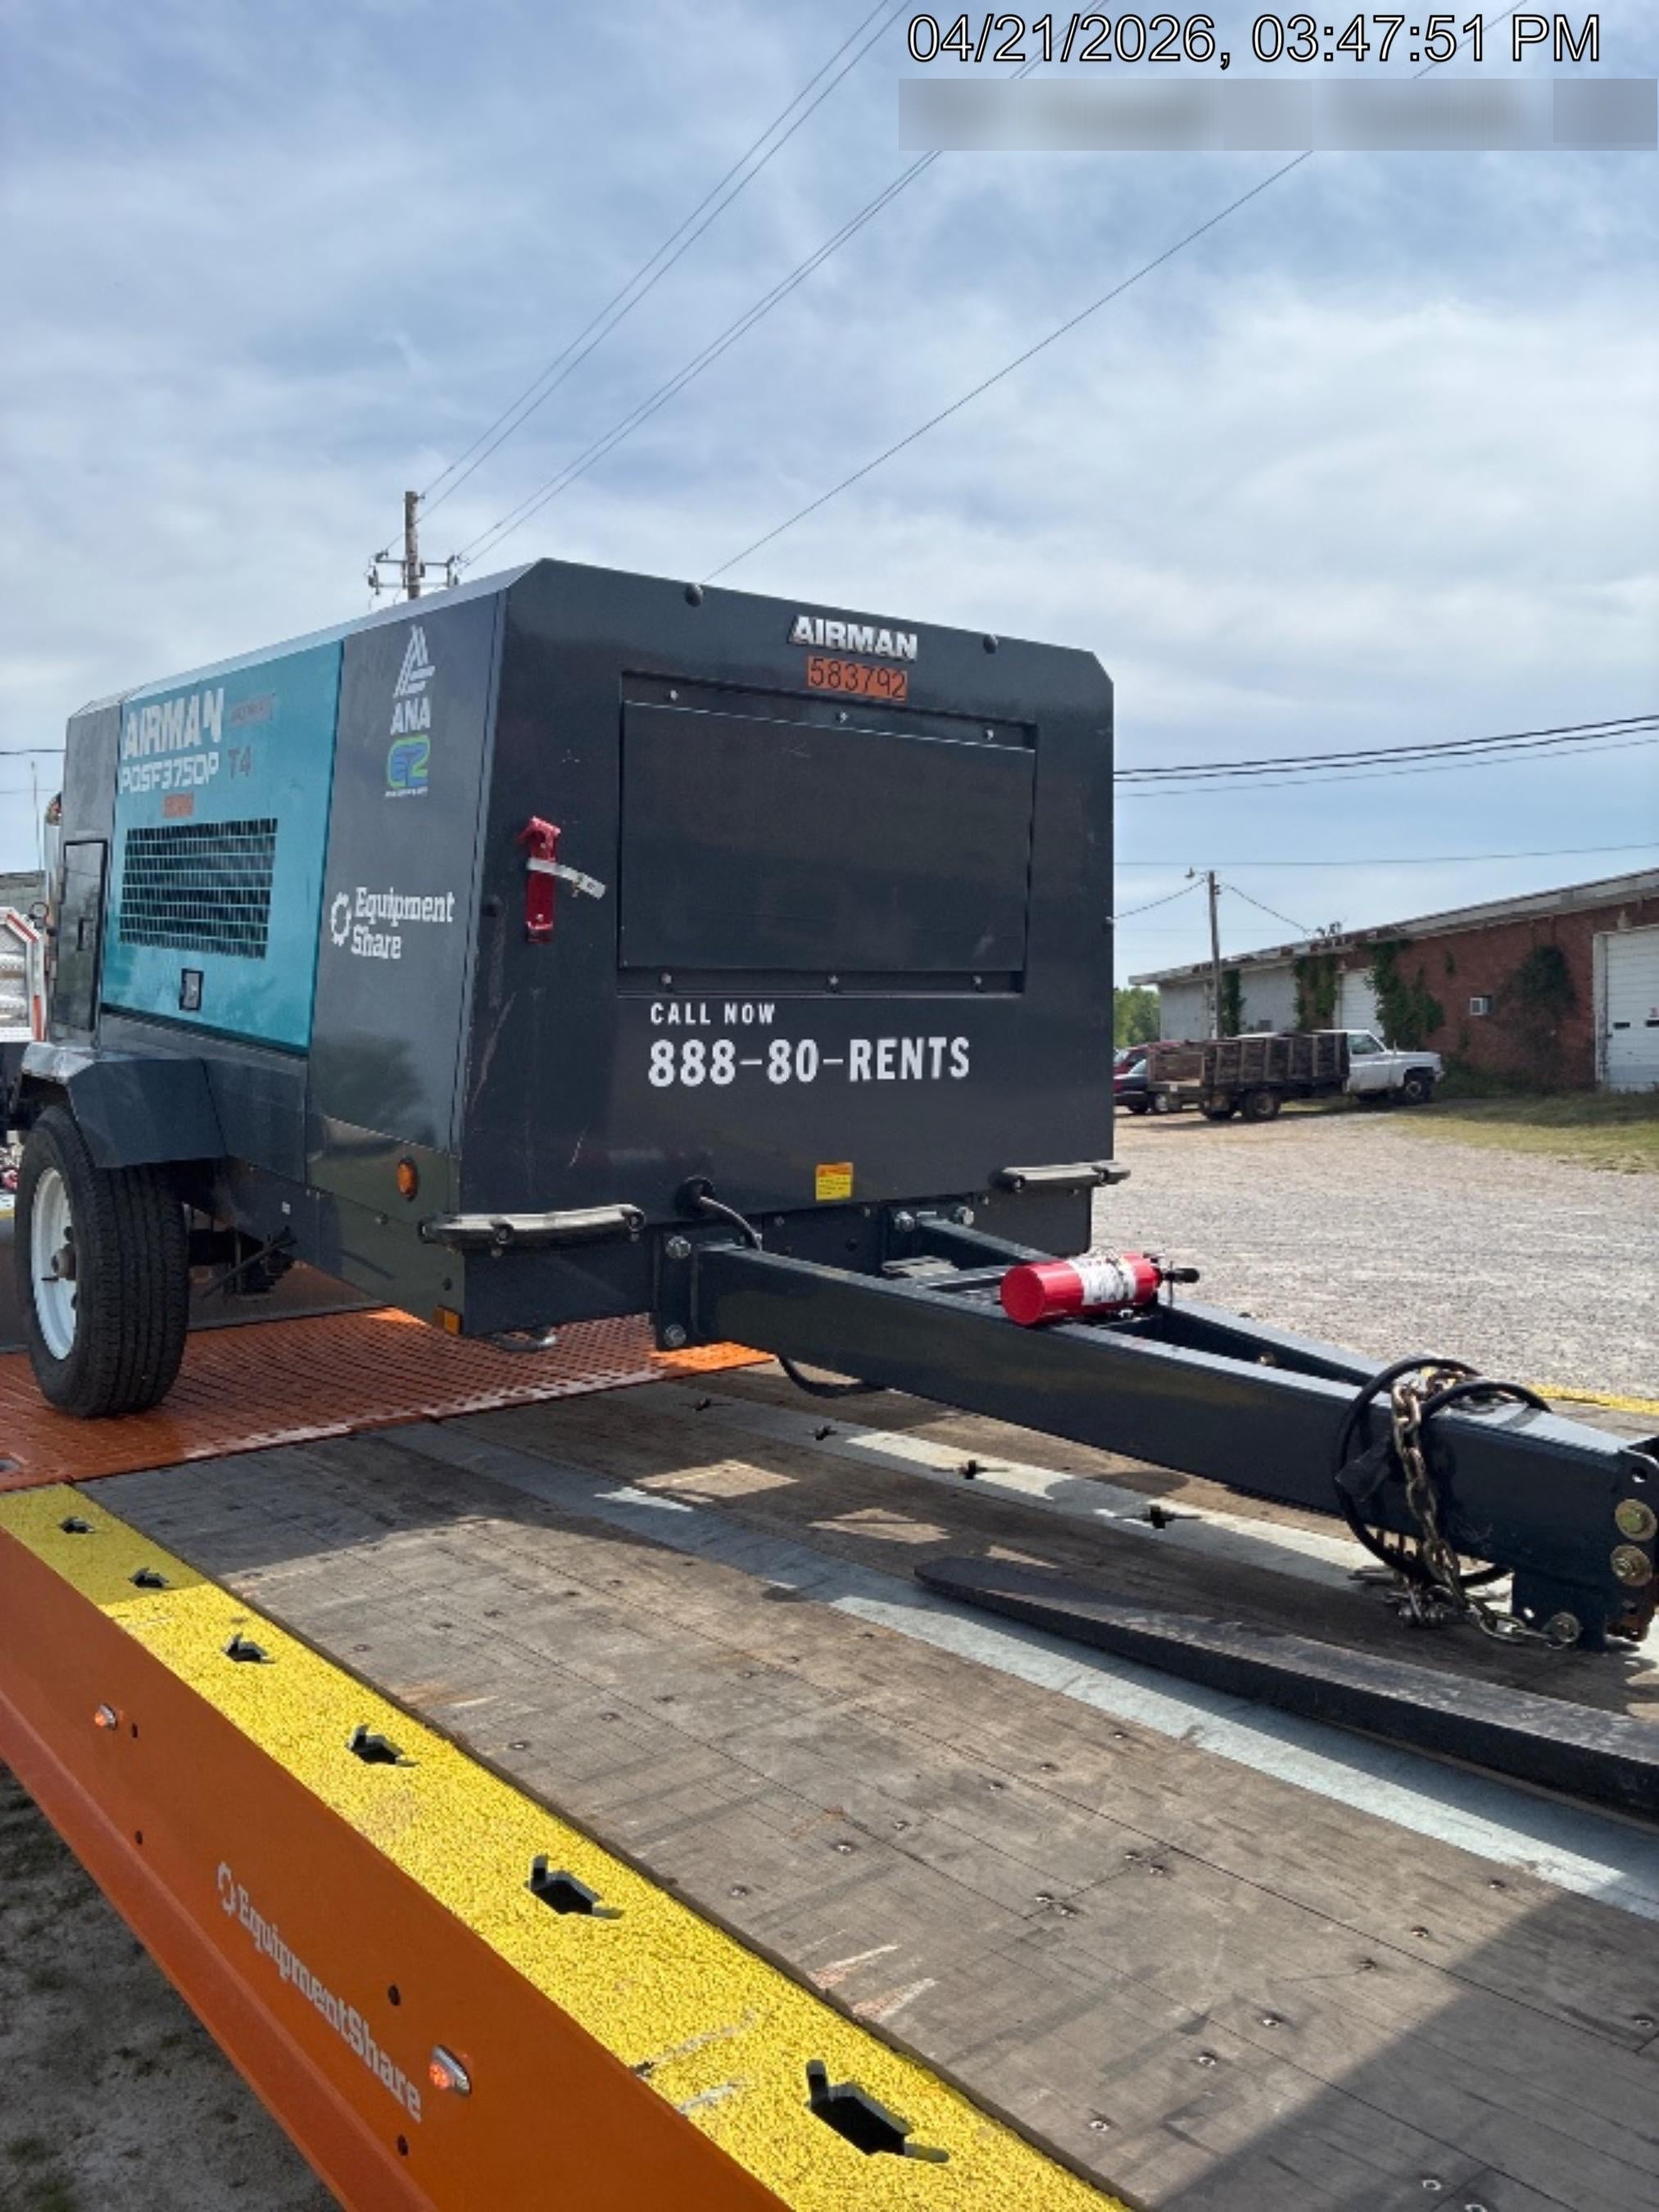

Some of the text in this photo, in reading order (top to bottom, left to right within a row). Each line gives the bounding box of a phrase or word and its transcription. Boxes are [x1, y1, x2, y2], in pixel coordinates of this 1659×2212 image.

[788, 615, 918, 662] AIRMAN
[810, 658, 905, 697] 583792
[122, 687, 224, 760] AIRMAN
[391, 696, 431, 735] ANA
[355, 886, 455, 927] Equipment
[351, 923, 401, 959] Share
[650, 1002, 775, 1025] CALL NOW
[648, 1036, 971, 1088] 888-80-RENTS
[238, 1884, 422, 2124] EquipmentShare
